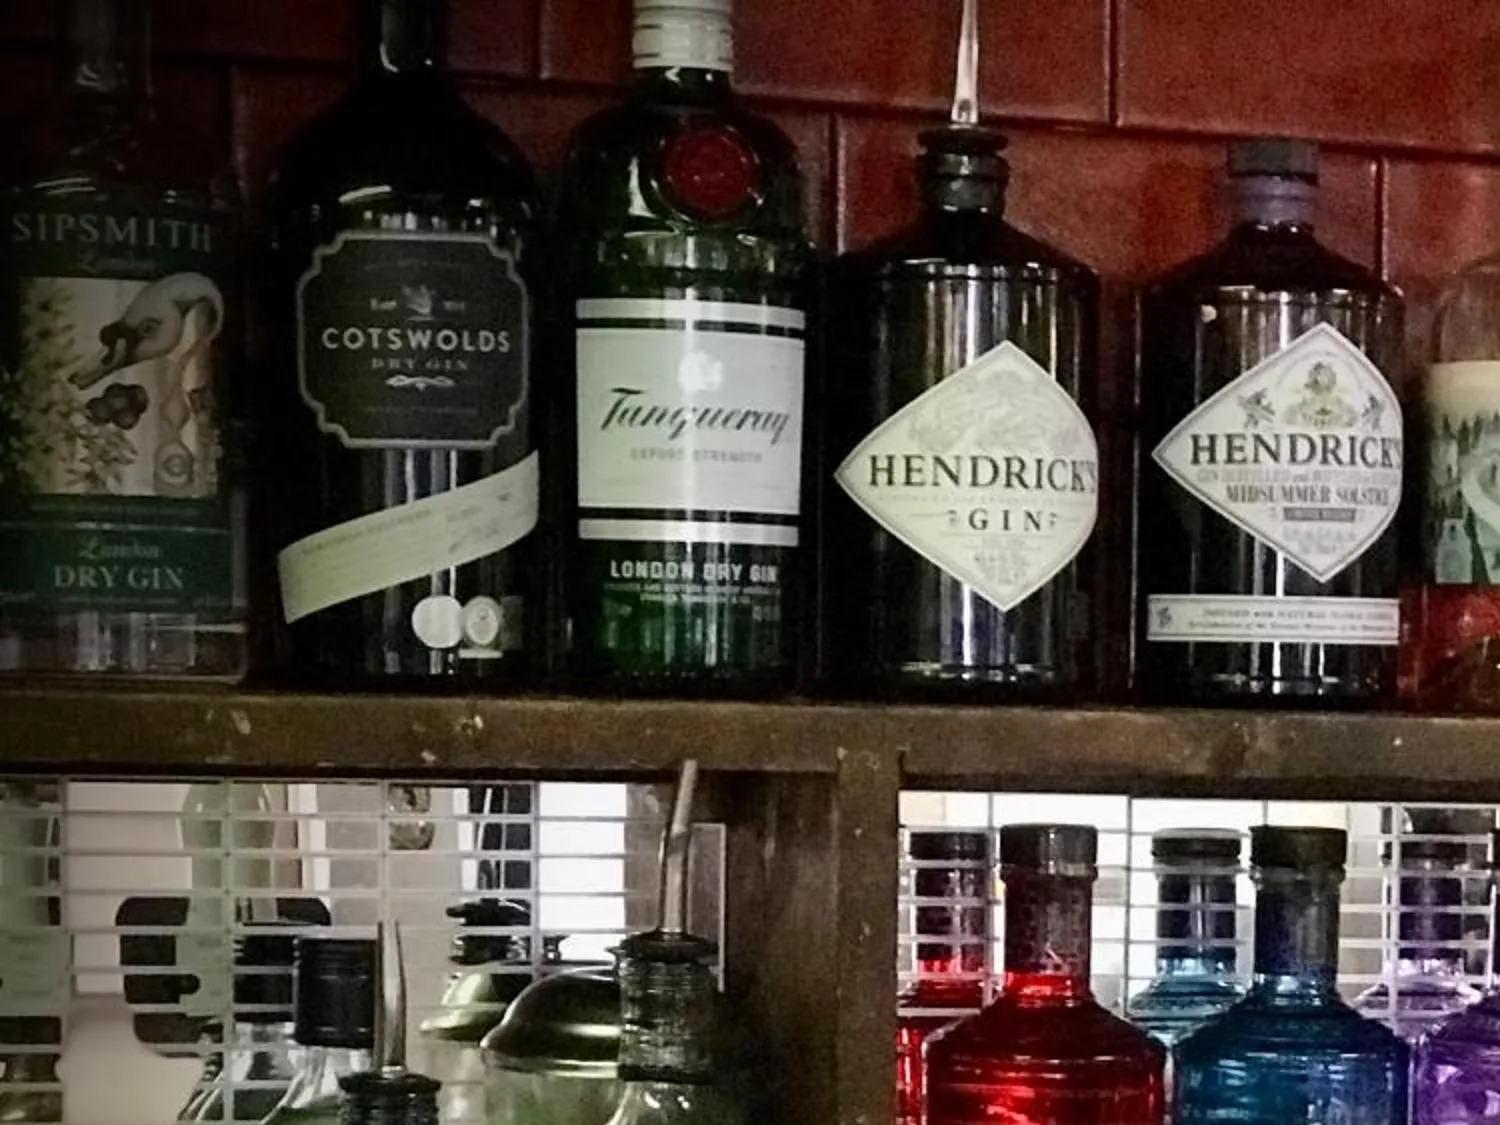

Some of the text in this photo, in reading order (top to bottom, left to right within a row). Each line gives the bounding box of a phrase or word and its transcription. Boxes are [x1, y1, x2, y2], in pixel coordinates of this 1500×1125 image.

[11, 211, 213, 253] SIPSMITH
[322, 326, 511, 353] COTSWOLDS
[600, 386, 791, 446] Tanqueray
[1226, 484, 1331, 504] MIDSUMMER
[968, 512, 1043, 532] GIN
[53, 565, 184, 590] DRY GIN
[610, 559, 777, 583] LONDON DRY GIN
